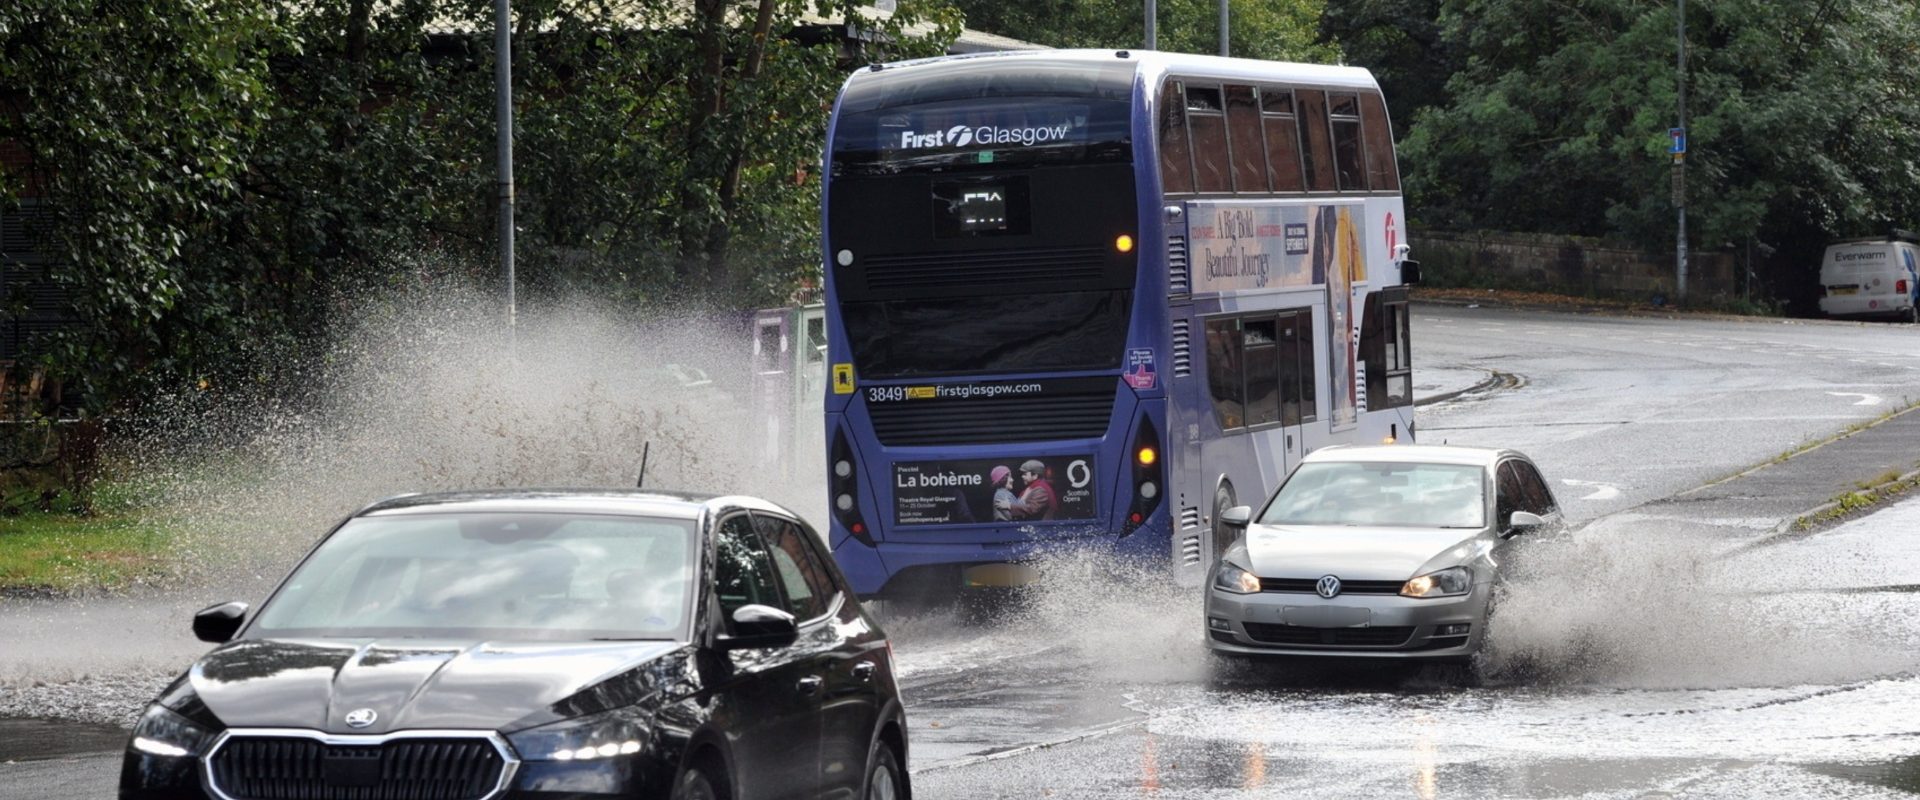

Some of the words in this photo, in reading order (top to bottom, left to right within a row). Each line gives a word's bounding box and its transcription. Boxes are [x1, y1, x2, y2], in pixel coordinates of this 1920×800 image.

[901, 130, 944, 149] First
[975, 125, 1068, 147] Glasgow
[1217, 212, 1223, 239] A
[1223, 210, 1237, 248] Big
[1237, 209, 1254, 238] Bold
[1835, 251, 1886, 262] Everwarm
[1205, 246, 1238, 281] Beautiful
[1241, 246, 1270, 288] Journey
[869, 386, 909, 402] 38491
[936, 383, 1042, 398] firstglasgow.com
[897, 473, 917, 488] La
[919, 471, 982, 487] bohème
